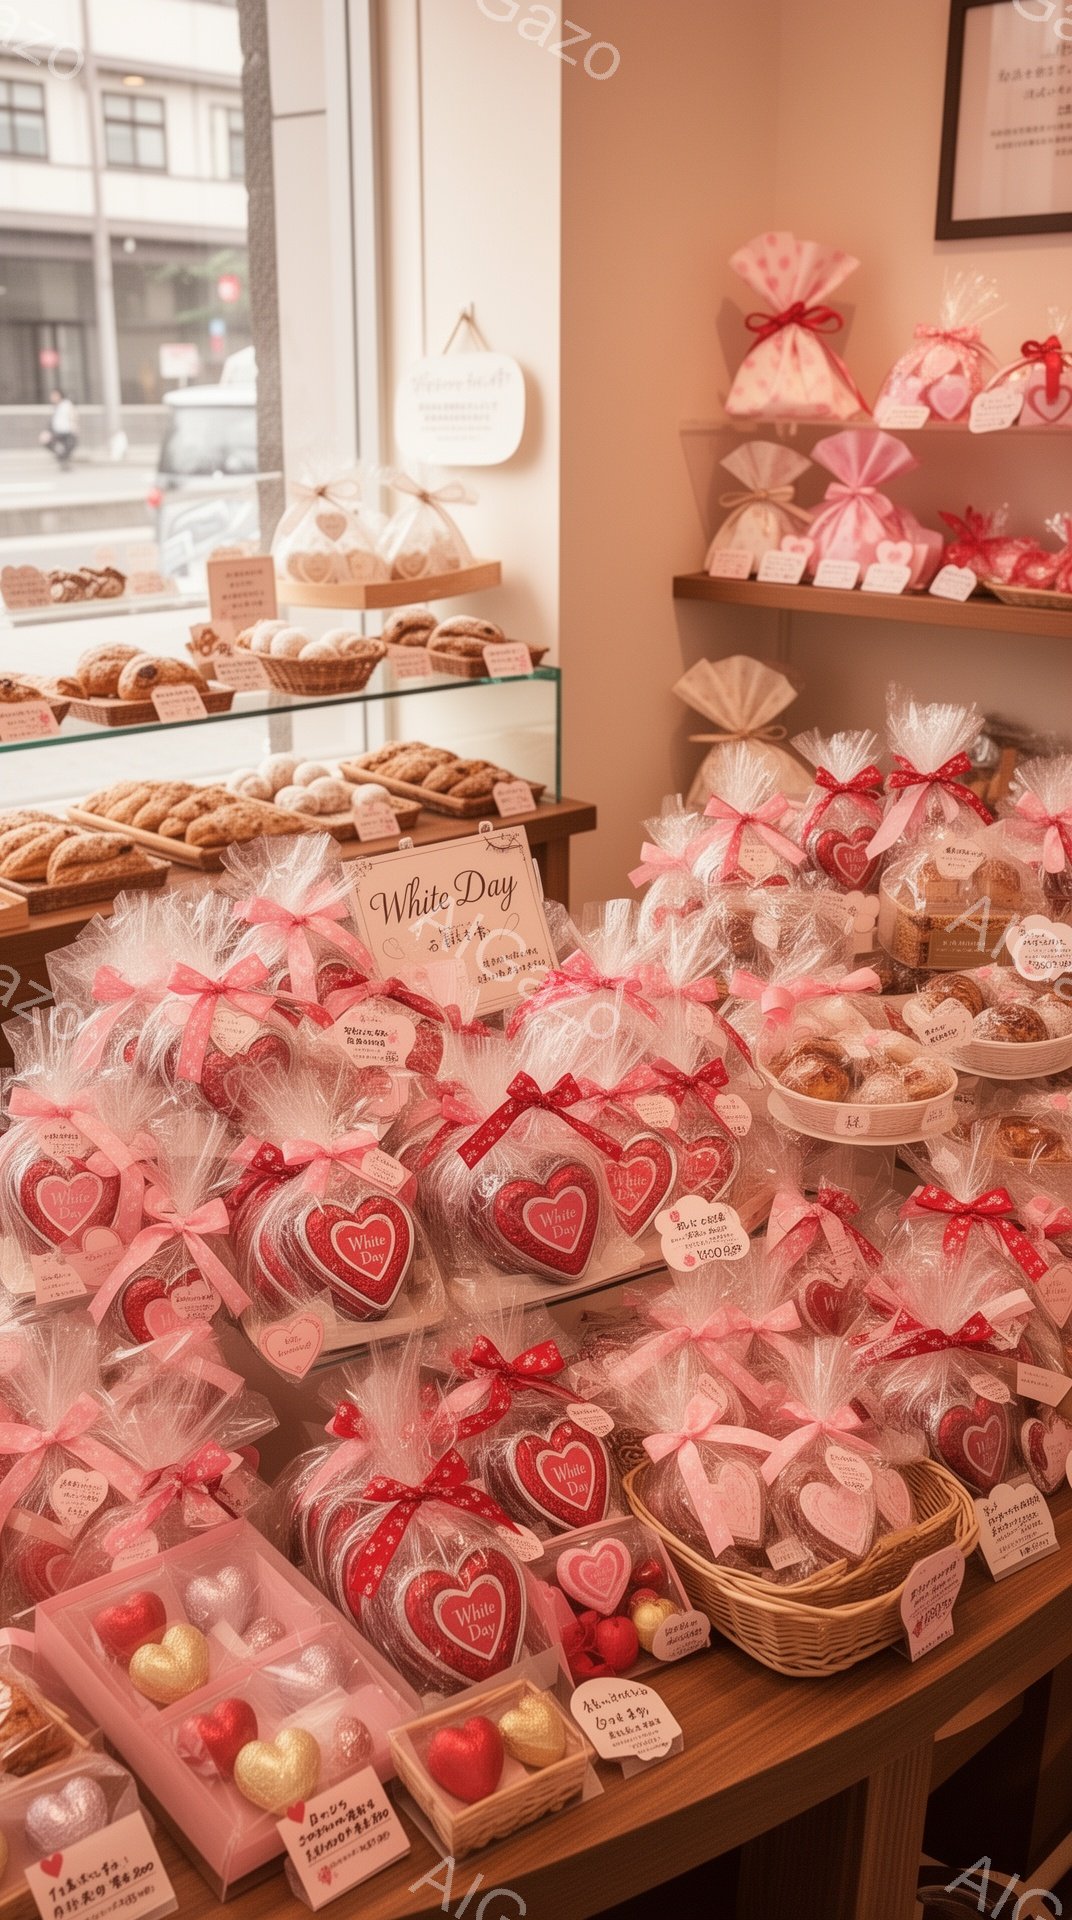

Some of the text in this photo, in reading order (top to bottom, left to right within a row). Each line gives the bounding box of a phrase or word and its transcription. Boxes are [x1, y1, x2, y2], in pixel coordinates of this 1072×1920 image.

[369, 870, 517, 925] White Day
[539, 1208, 577, 1228] White
[552, 1224, 577, 1239] Day
[346, 1234, 386, 1252] White
[360, 1251, 385, 1266] Day
[567, 1481, 590, 1497] Day
[468, 1623, 496, 1642] Day
